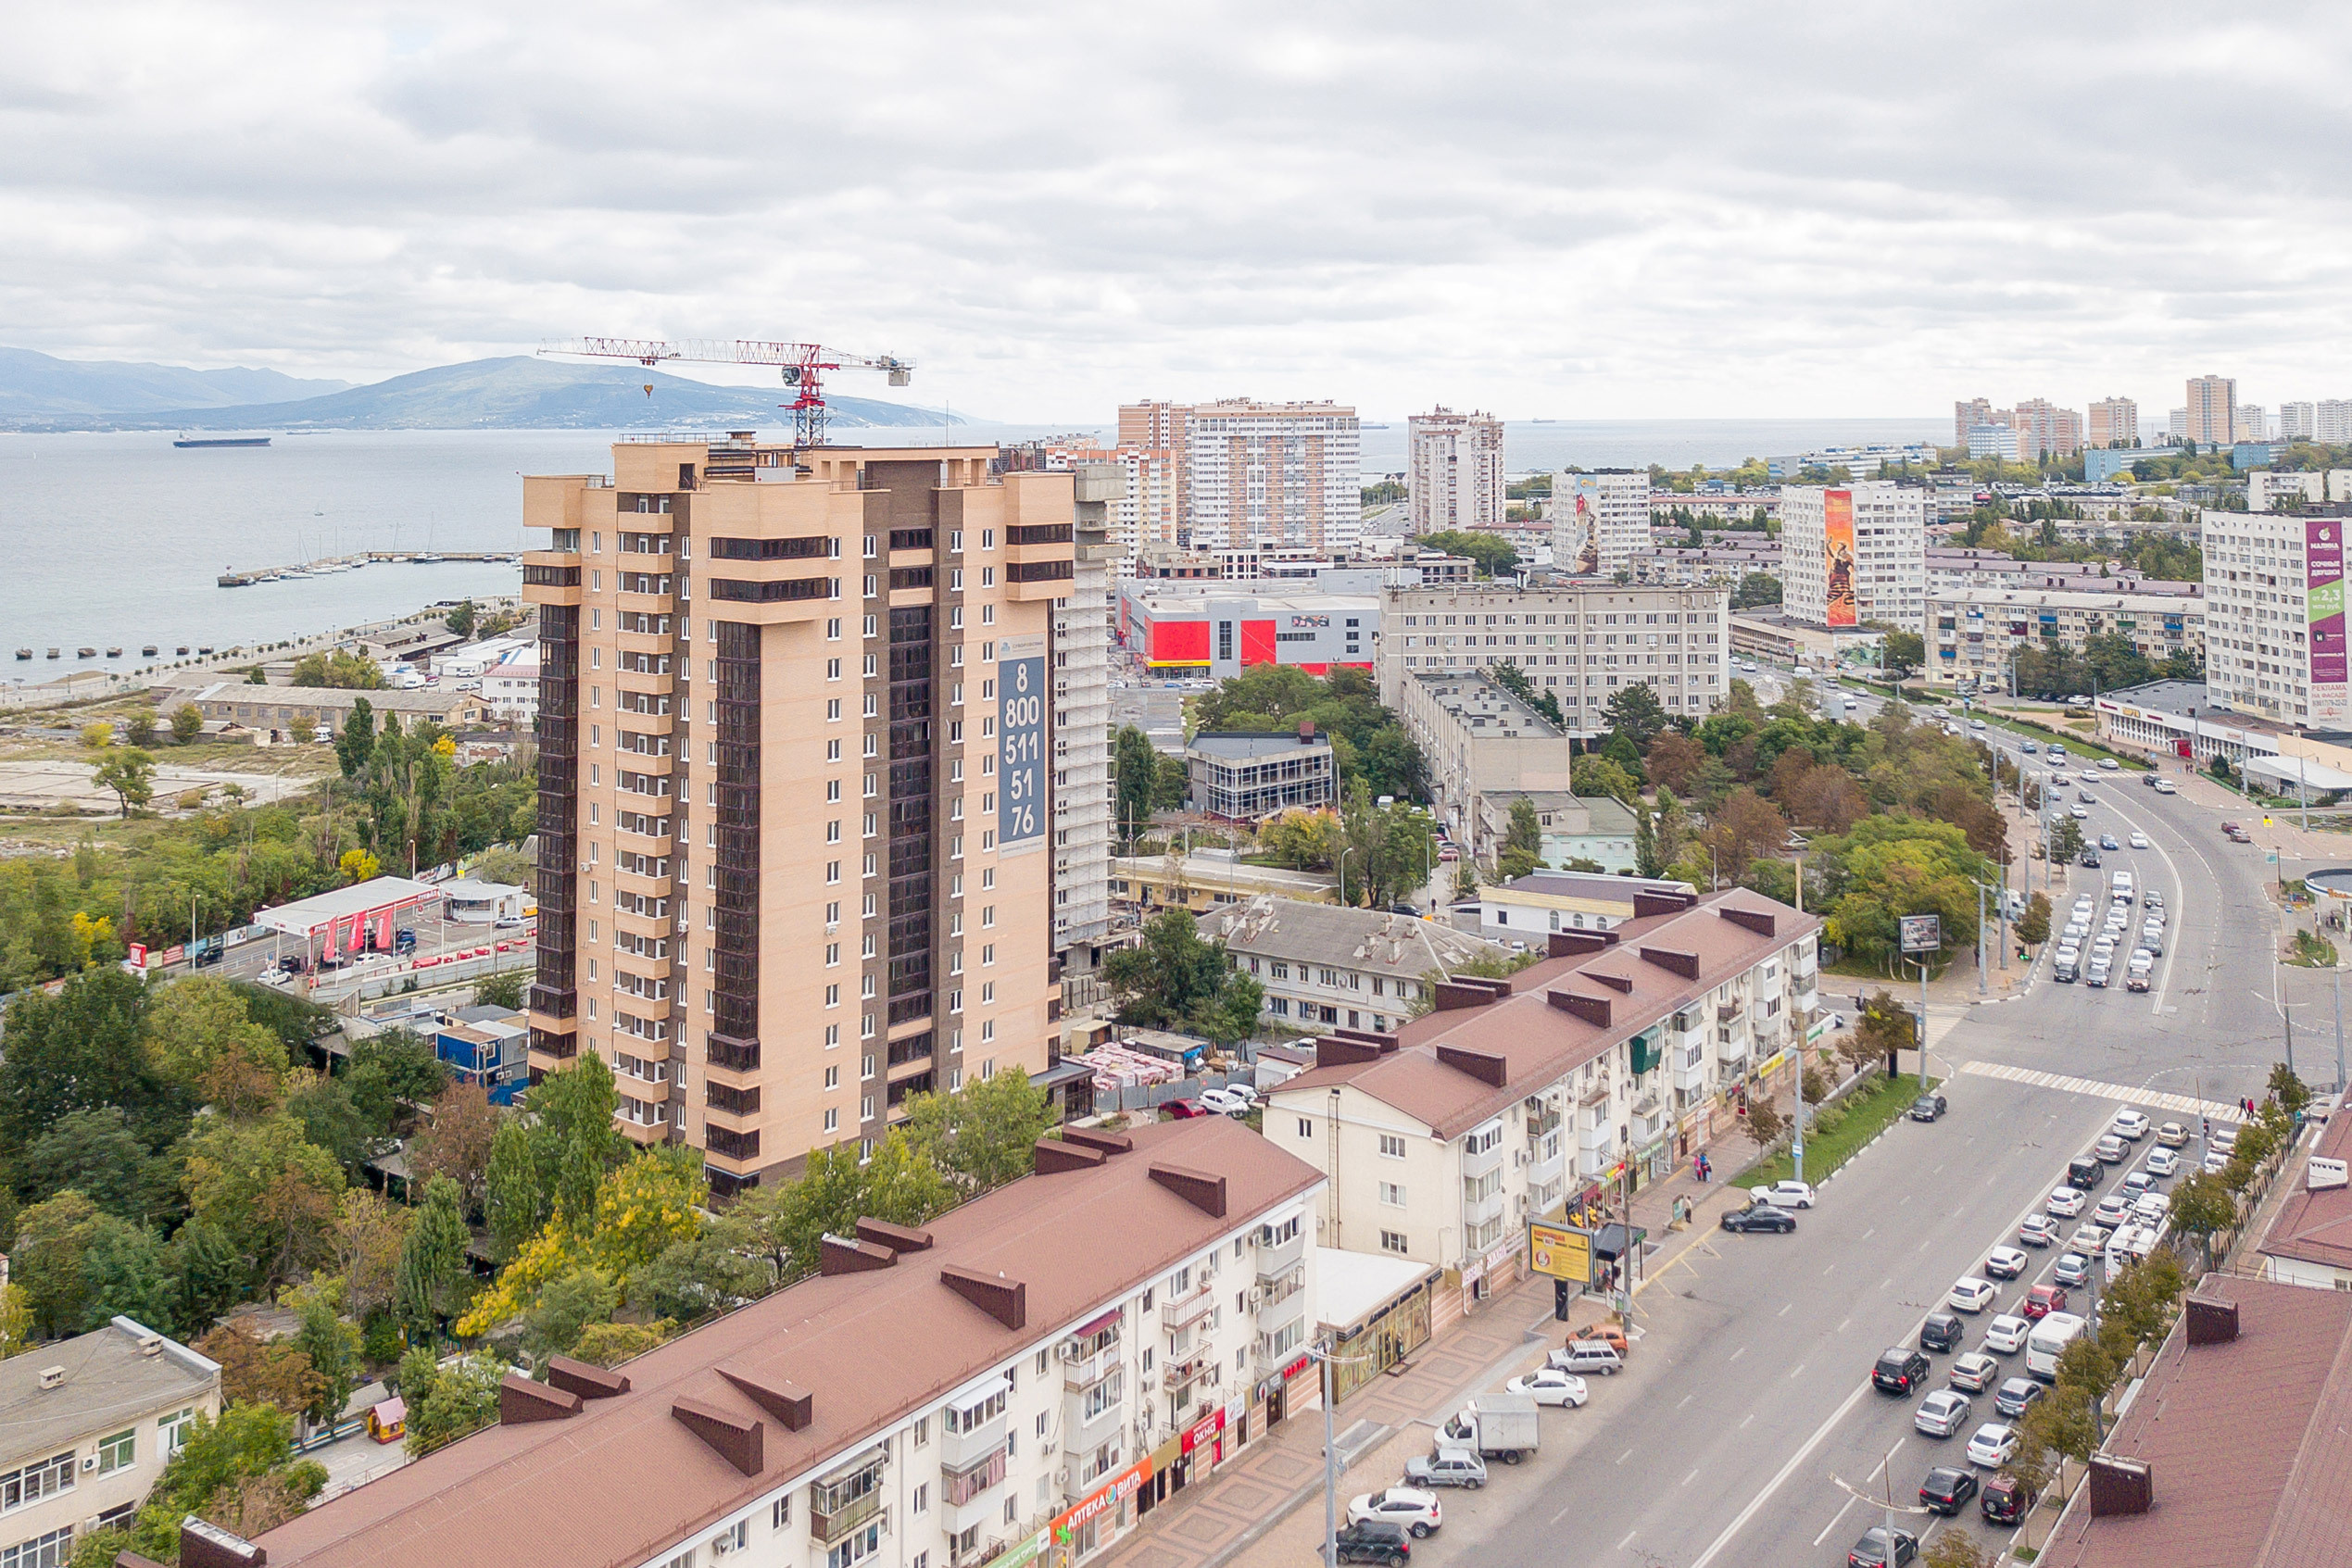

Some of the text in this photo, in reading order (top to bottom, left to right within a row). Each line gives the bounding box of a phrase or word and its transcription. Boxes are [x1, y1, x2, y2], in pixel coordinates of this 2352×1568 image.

[2321, 589, 2341, 602] 2,3
[1016, 662, 1028, 692] 8
[1005, 695, 1039, 729] 800
[1004, 731, 1038, 765] 511
[1010, 768, 1033, 800] 51
[1011, 803, 1035, 836] 76
[1067, 1494, 1106, 1531] АПТЕКА
[1117, 1470, 1141, 1497] ВИТА
